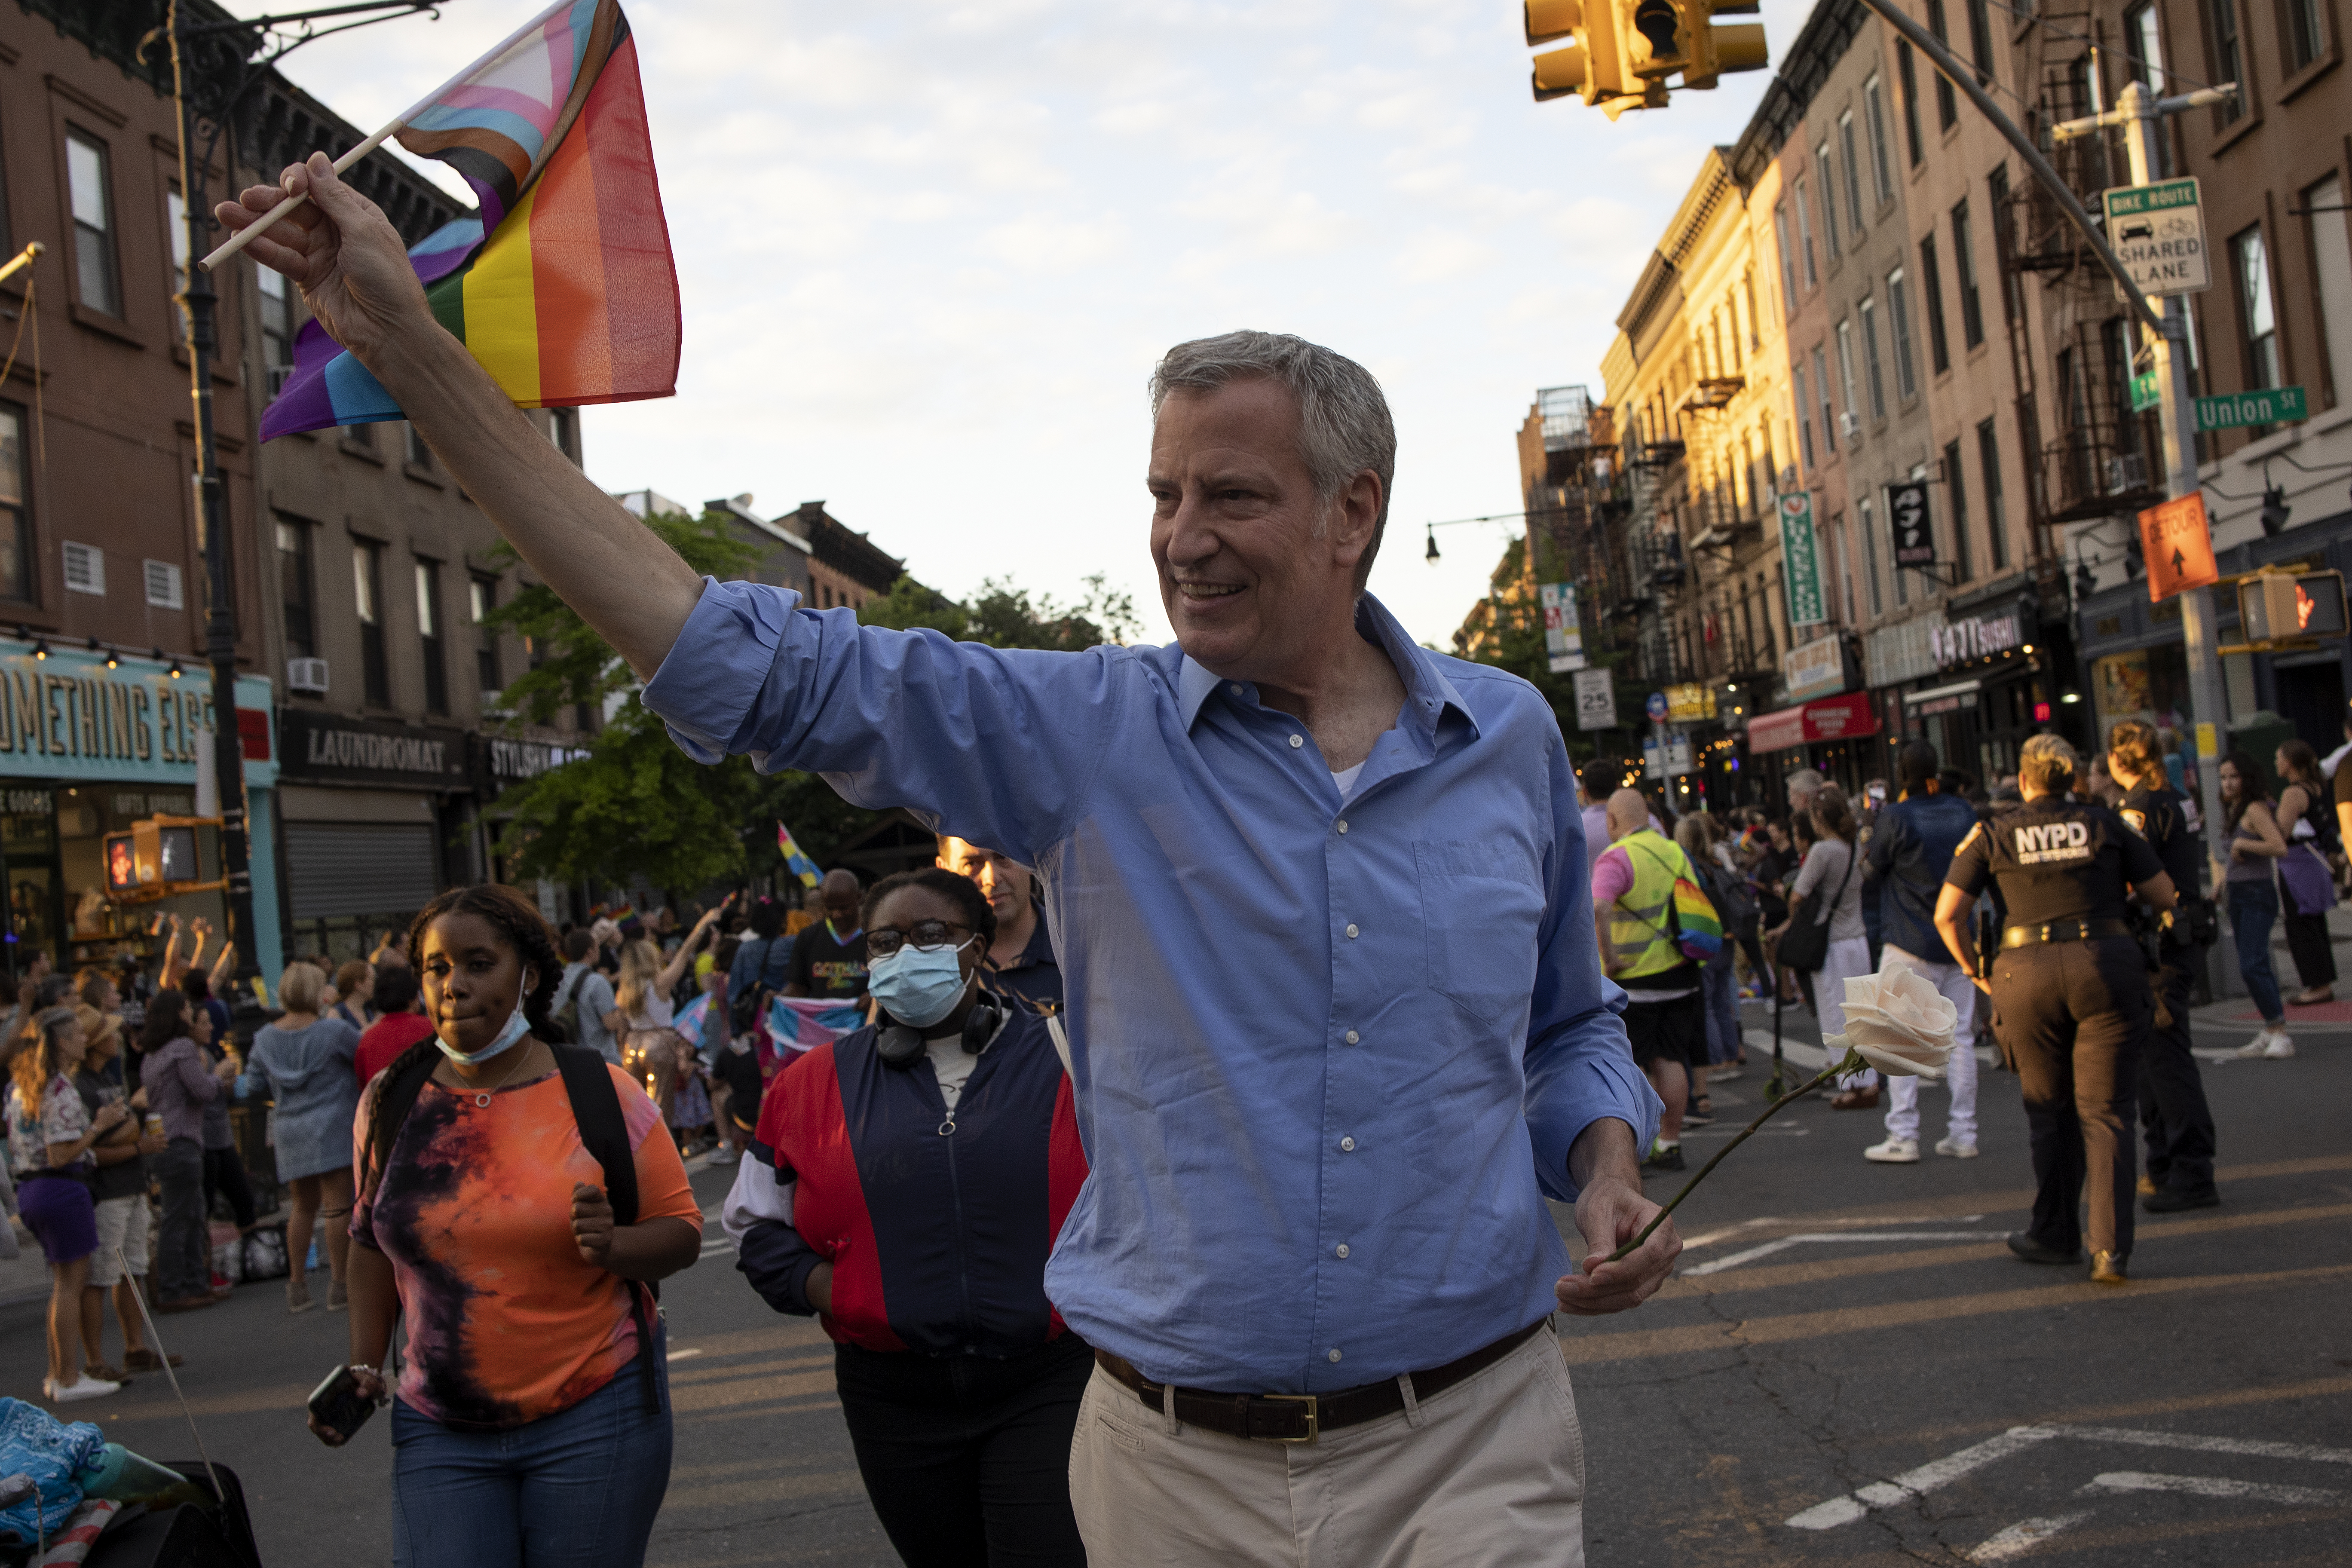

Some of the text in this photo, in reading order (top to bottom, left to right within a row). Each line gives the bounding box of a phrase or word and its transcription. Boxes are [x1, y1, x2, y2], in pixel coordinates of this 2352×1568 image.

[2111, 186, 2193, 213] BIKE ROUTE
[2119, 237, 2199, 264] SHARED
[2133, 260, 2191, 284] LANE
[2200, 391, 2297, 427] Union St
[2149, 507, 2199, 544] DETOUR
[1583, 692, 1608, 710] 25
[308, 729, 446, 773] LAUNDROMAT
[2014, 821, 2088, 854] NYPD
